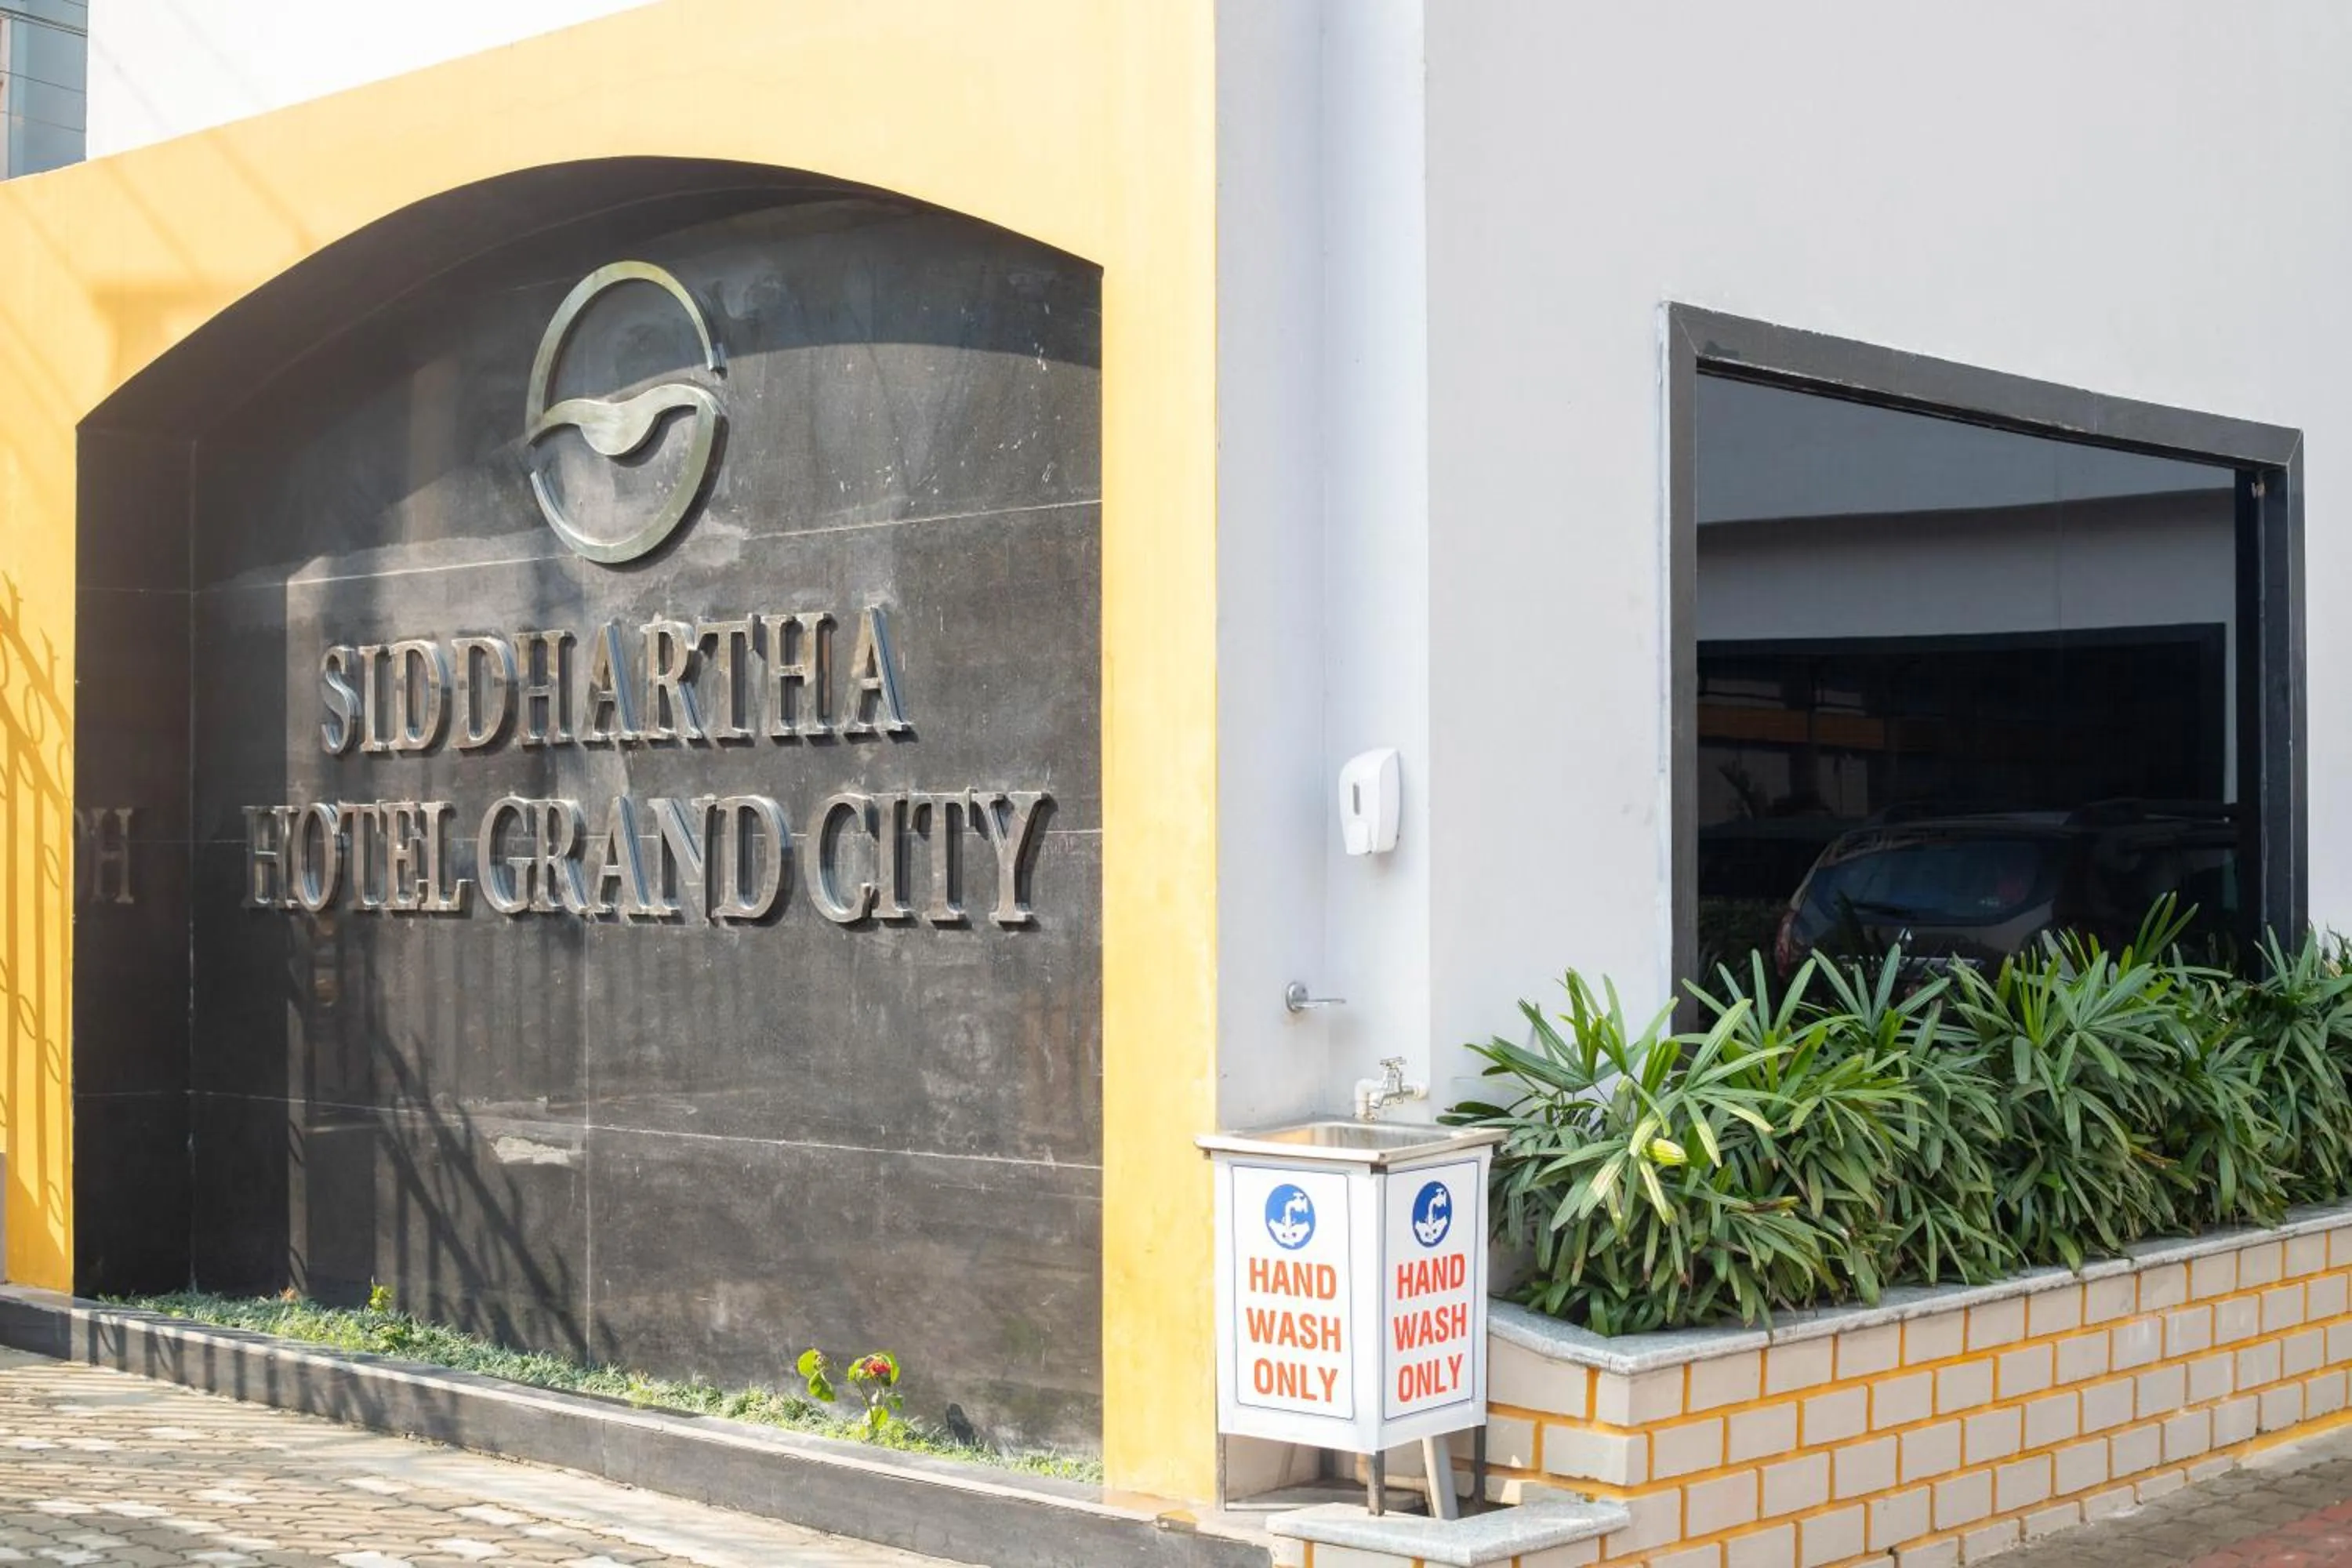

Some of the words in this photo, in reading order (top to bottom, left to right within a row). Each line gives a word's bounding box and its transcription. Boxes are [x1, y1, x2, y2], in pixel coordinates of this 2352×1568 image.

[321, 605, 914, 754] SIDDHARTHA
[242, 800, 473, 913] HOTEL
[477, 793, 791, 922] GRAND
[804, 788, 1055, 925] CITY
[1249, 1257, 1337, 1300] HAND
[1396, 1254, 1465, 1300] HAND
[1246, 1307, 1341, 1352] WASH
[1393, 1303, 1467, 1352] WASH
[1254, 1358, 1338, 1403] ONLY
[1397, 1353, 1464, 1403] ONLY
